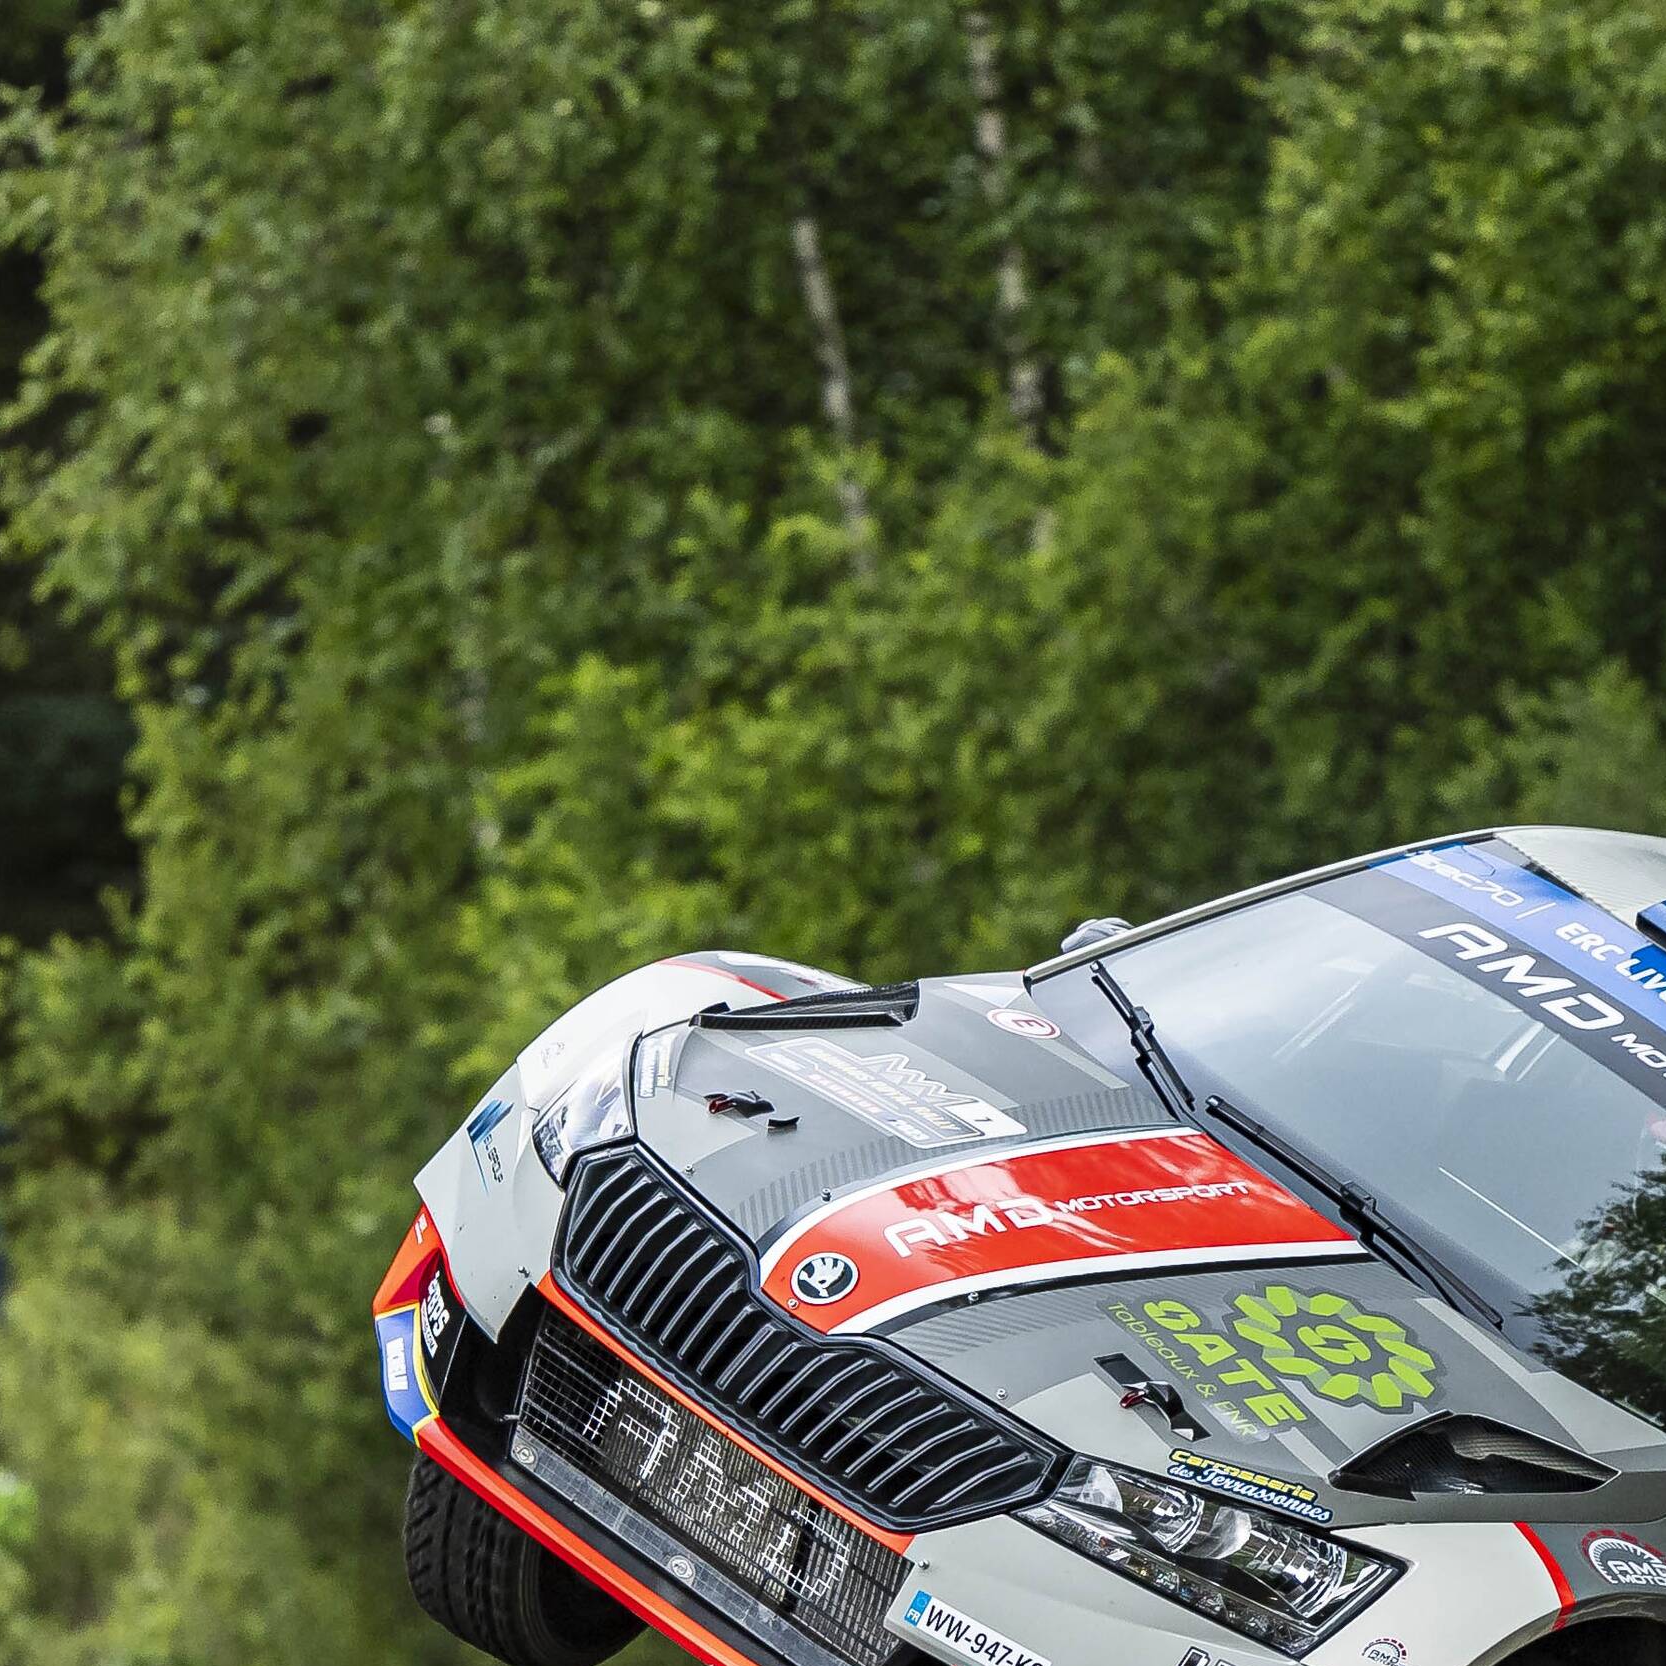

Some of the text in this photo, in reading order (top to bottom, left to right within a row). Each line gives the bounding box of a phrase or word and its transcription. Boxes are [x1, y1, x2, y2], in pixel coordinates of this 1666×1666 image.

[1417, 922, 1625, 1030] AMD
[1555, 922, 1625, 961] ERC
[883, 1181, 1250, 1258] AMD MOTORSPORT
[1107, 1302, 1200, 1379] Tableaux
[1195, 1383, 1218, 1399] &
[1143, 1300, 1308, 1427] SATE
[1169, 1464, 1331, 1522] des Terrassonnes
[907, 1608, 920, 1623] FR
